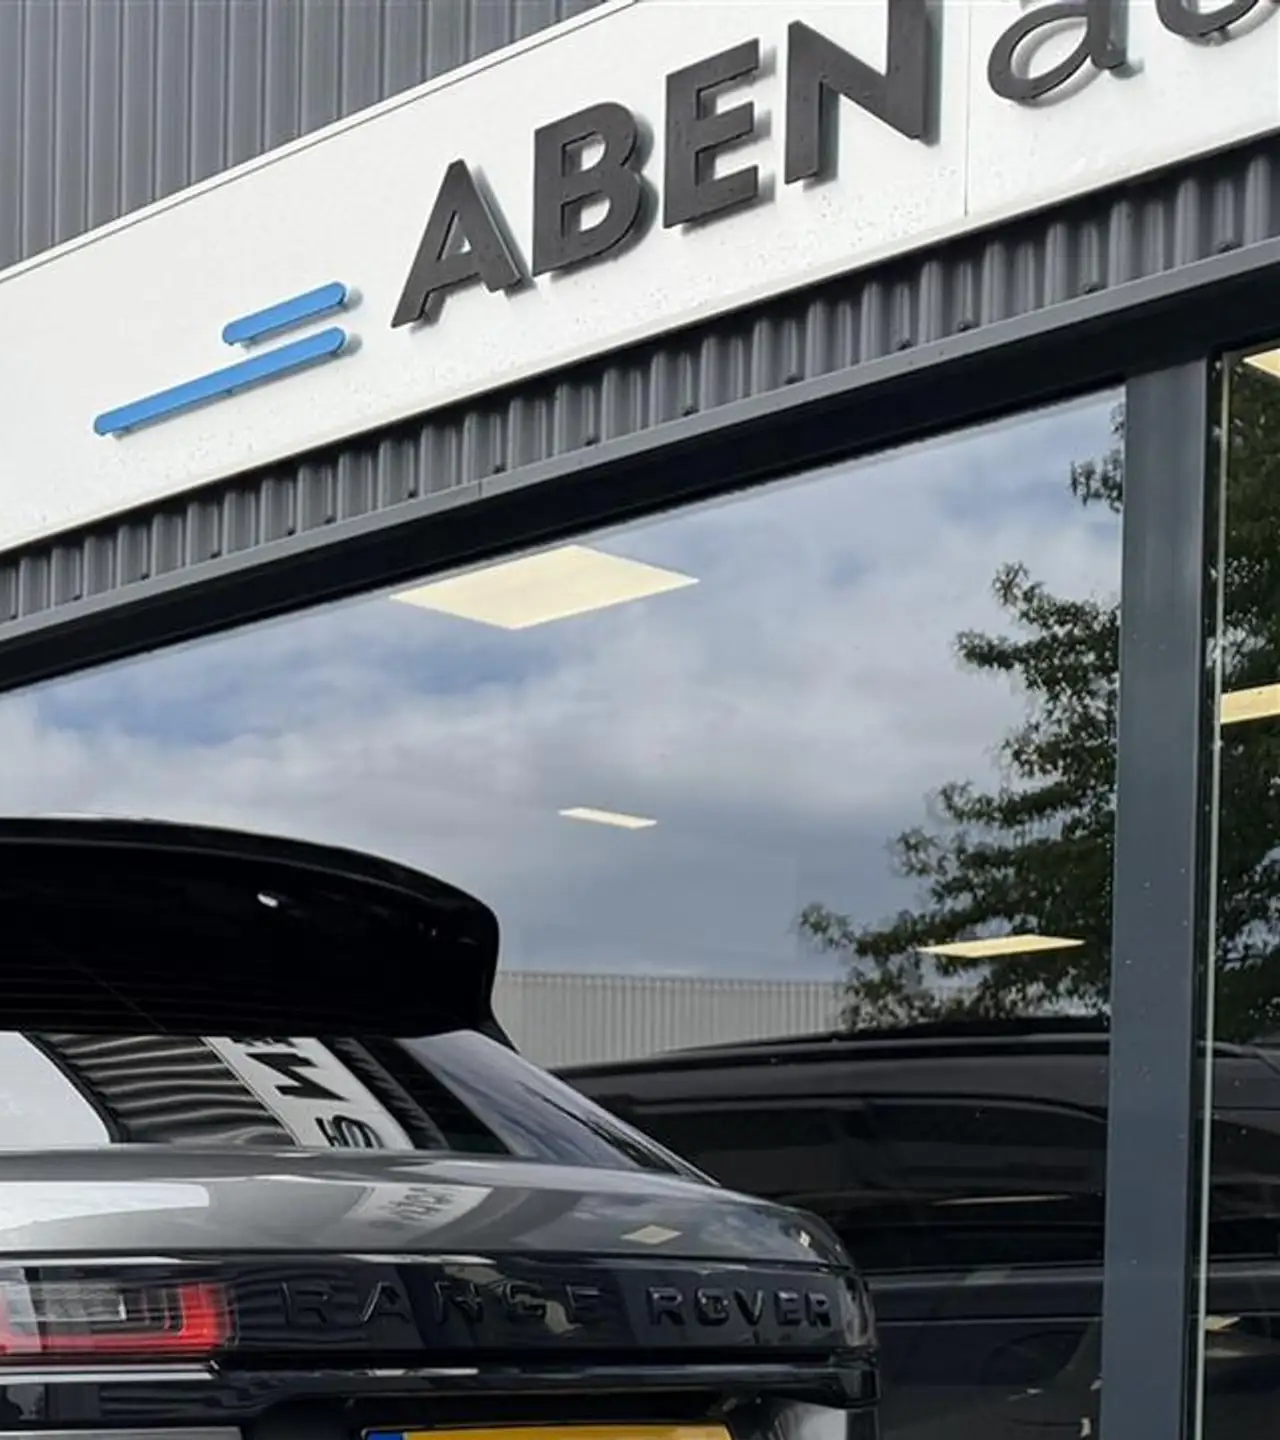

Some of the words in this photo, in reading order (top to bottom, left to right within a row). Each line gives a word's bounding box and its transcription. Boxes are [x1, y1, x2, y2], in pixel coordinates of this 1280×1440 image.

[391, 0, 927, 328] ABEN
[280, 1281, 603, 1326] RANGE
[647, 1286, 833, 1327] ROVER
